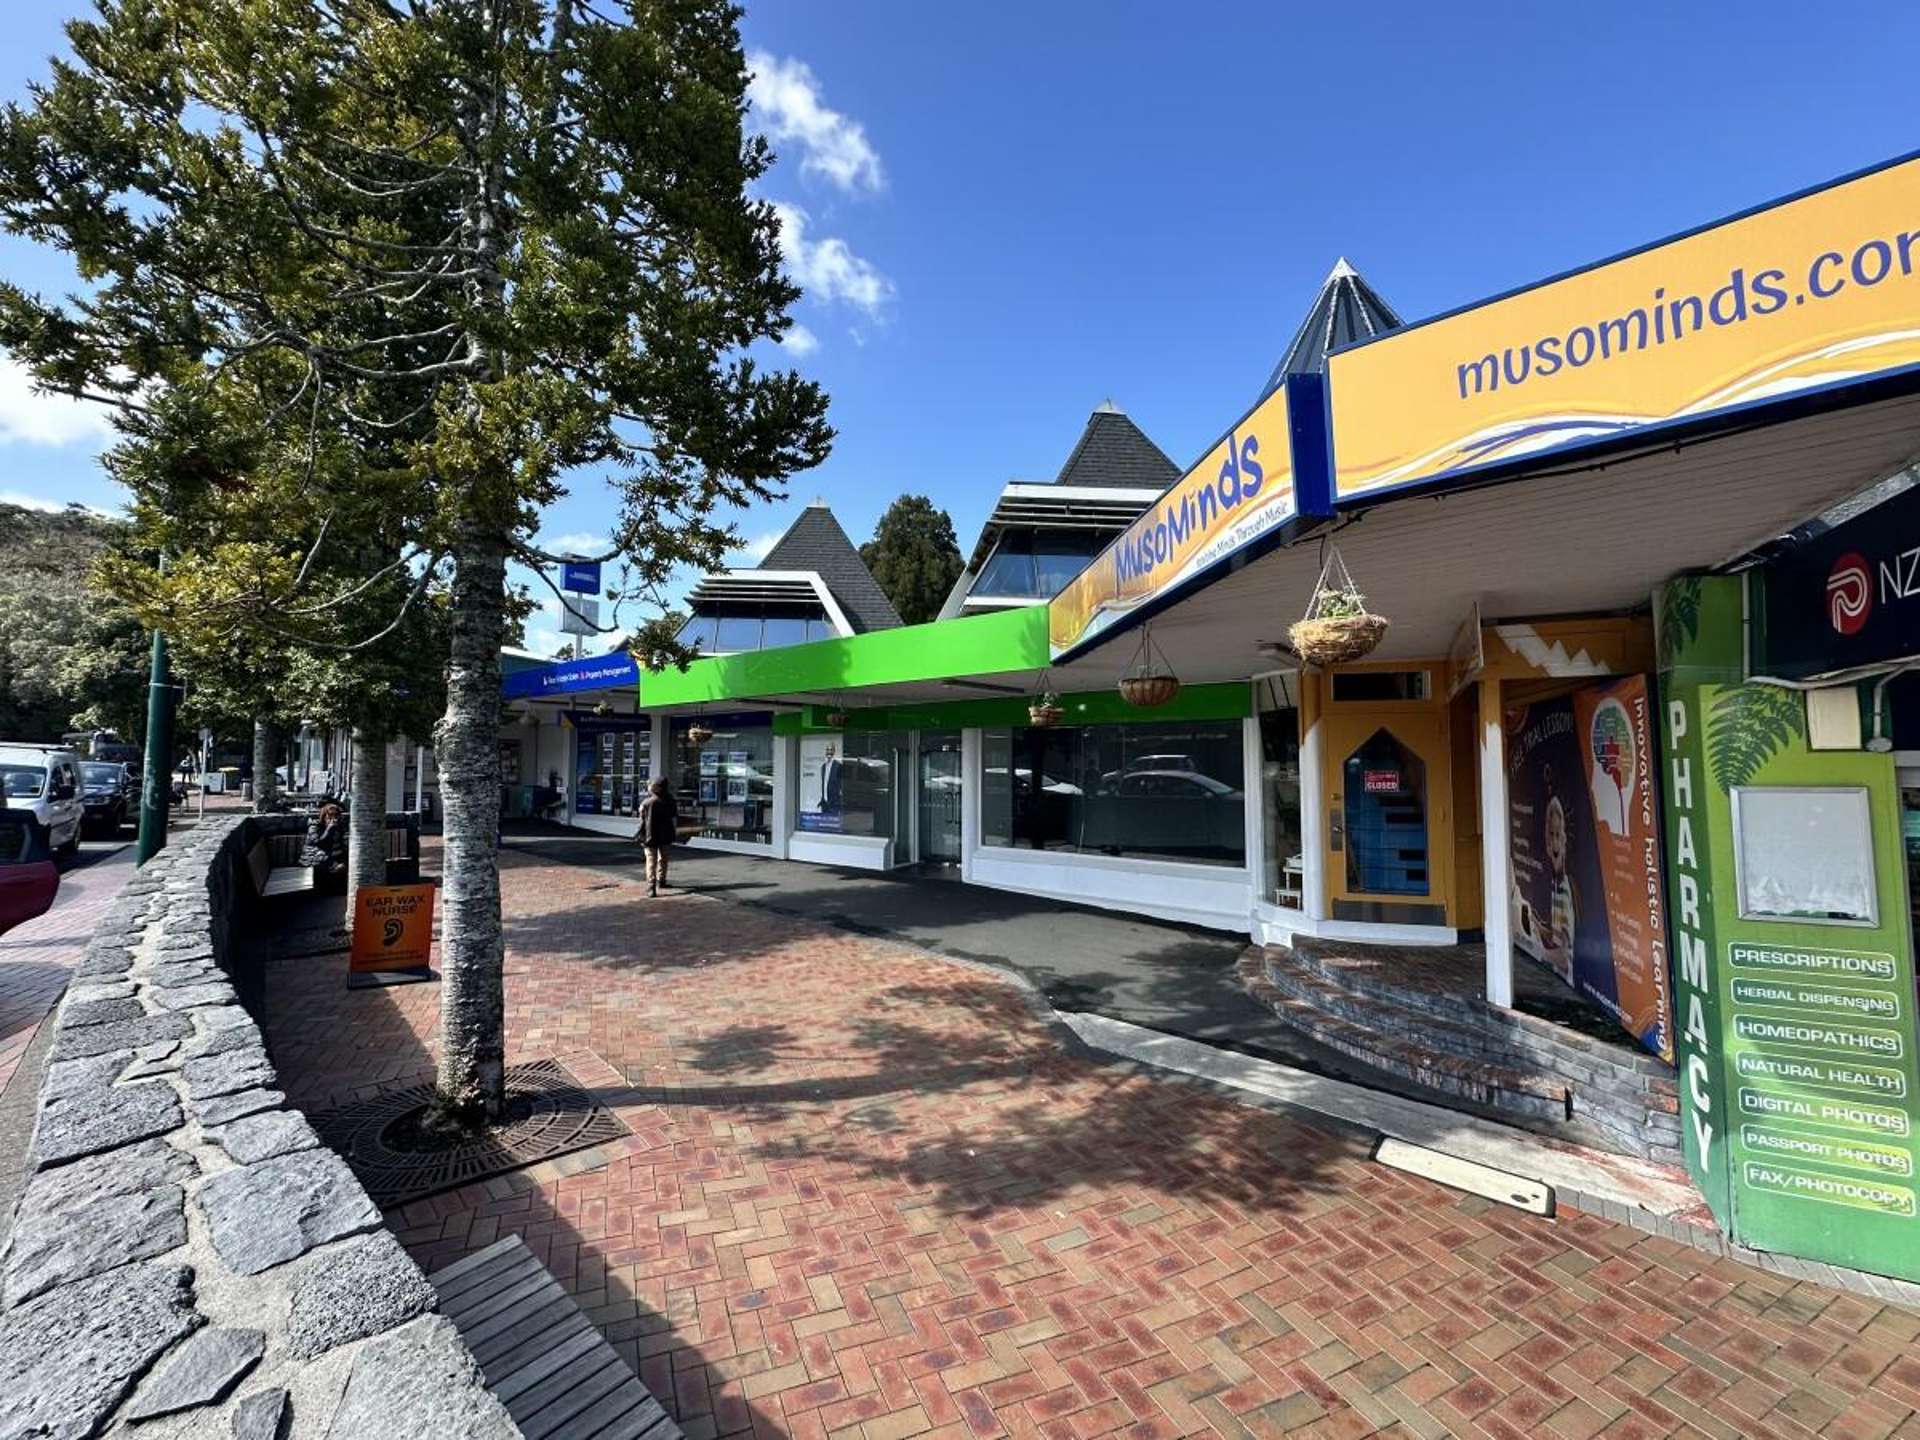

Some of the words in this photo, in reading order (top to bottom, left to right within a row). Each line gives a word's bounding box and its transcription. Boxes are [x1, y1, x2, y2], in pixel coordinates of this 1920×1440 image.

[1880, 546, 1920, 604] NZ
[1366, 781, 1398, 790] CLOSED
[1634, 697, 1651, 826] Innovative
[1644, 837, 1660, 930] holistic
[1669, 700, 1713, 1173] PHARMACY
[1734, 949, 1892, 975] PRESCRIPTIONS
[1737, 986, 1796, 1001] HERBAL
[1798, 992, 1895, 1011] DISPENSING
[1738, 1021, 1898, 1051] HOMEOPATHICS
[1742, 1058, 1825, 1080] NATURAL
[1828, 1069, 1901, 1090] HEALTH
[1745, 1095, 1818, 1117] DIGITAL
[1821, 1105, 1905, 1130] PHOTOS
[1746, 1132, 1832, 1156] PASSPORT
[1837, 1147, 1908, 1170] PHOTOS
[1749, 1167, 1911, 1206] FAX/PHOTOCOPY
